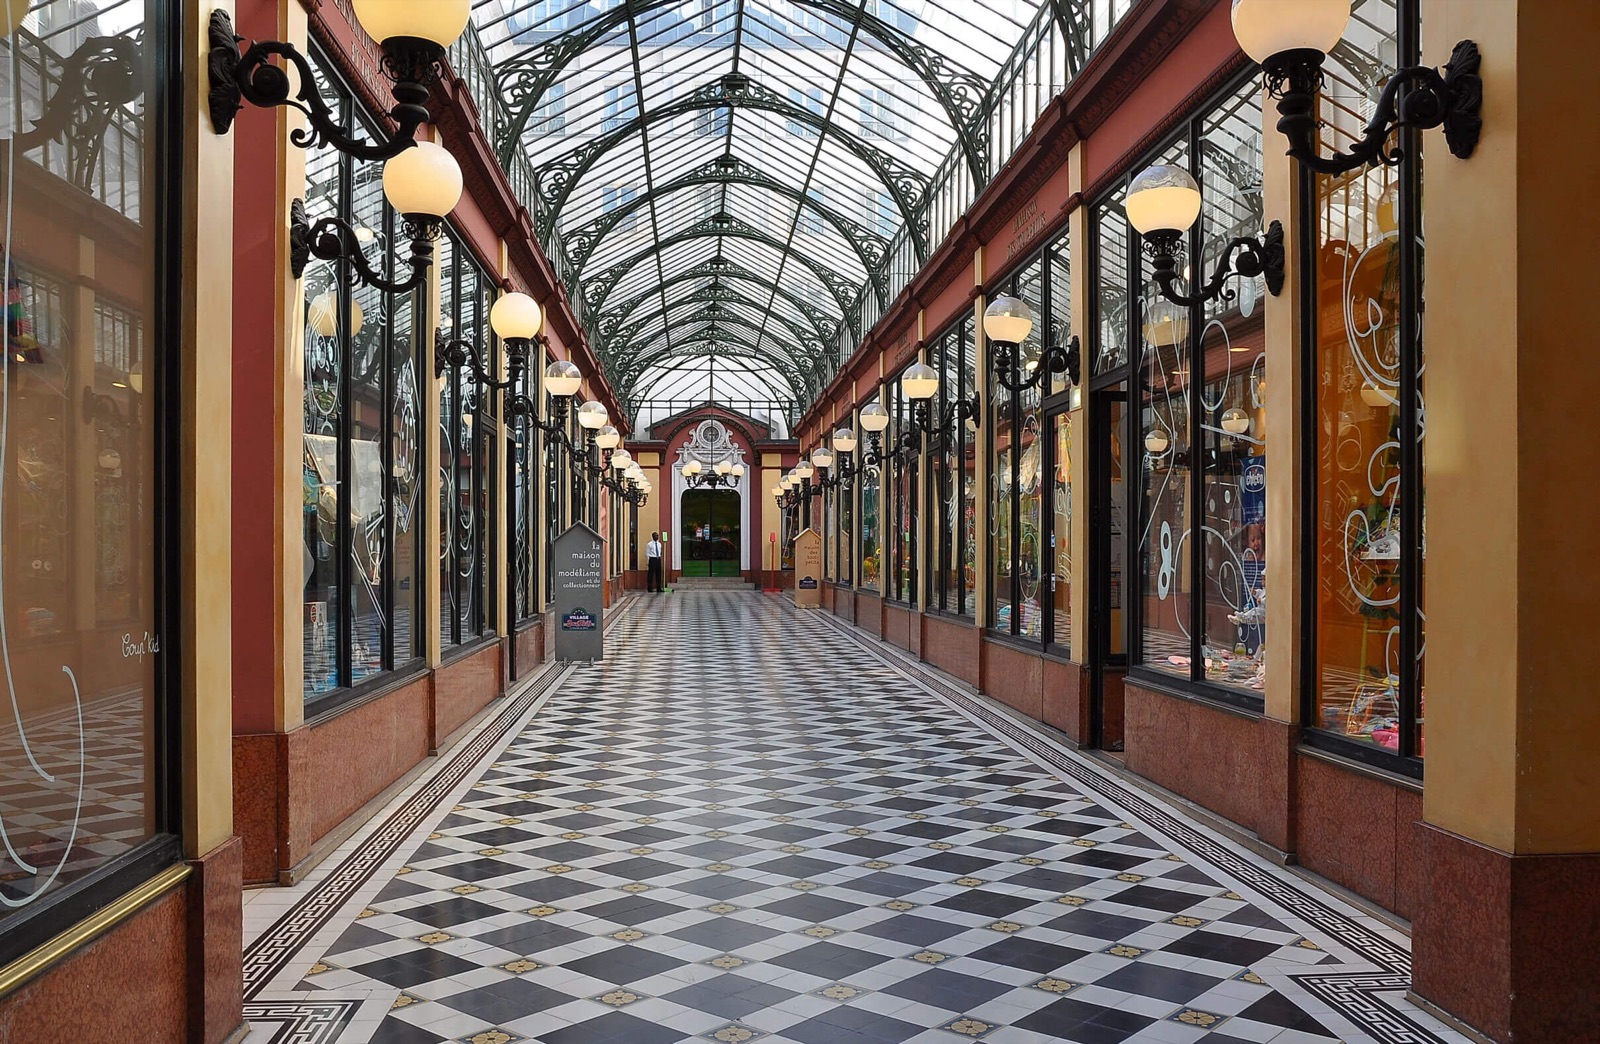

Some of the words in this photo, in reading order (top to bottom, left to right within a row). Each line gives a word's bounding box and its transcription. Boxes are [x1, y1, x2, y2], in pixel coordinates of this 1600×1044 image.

[592, 541, 600, 550] la
[572, 551, 600, 559] maison
[590, 559, 600, 568] du
[558, 568, 600, 576] modélisme
